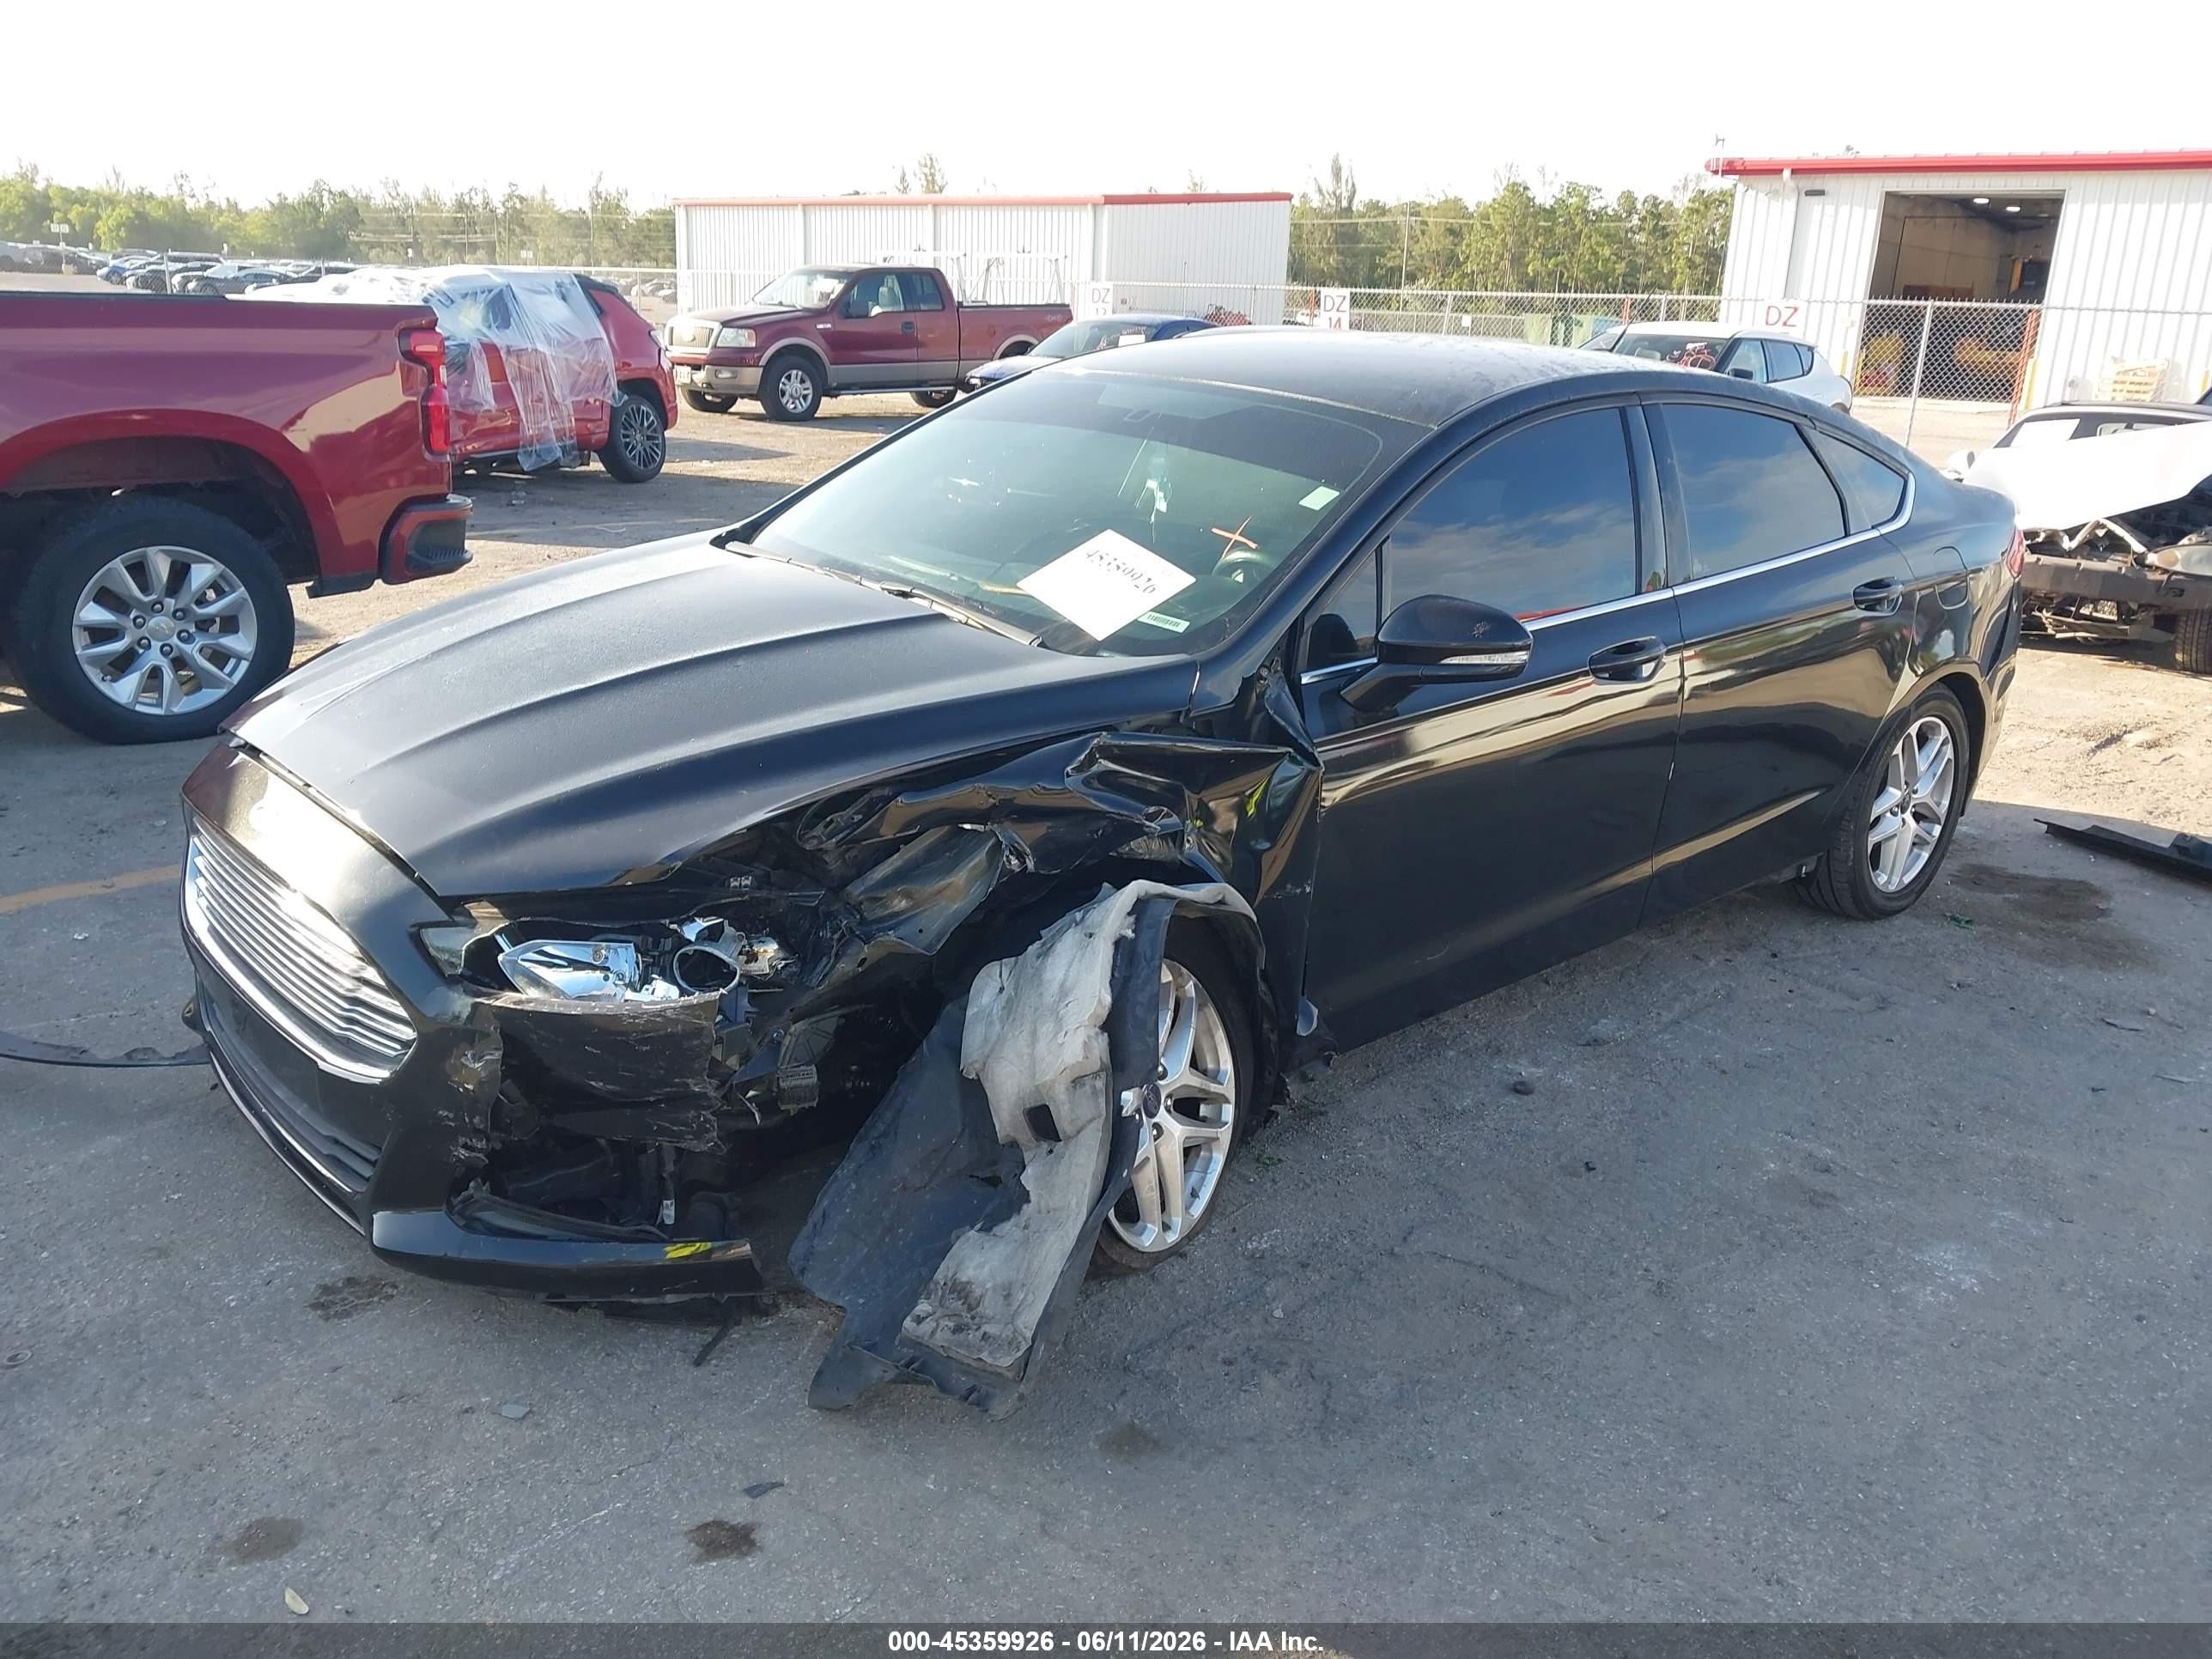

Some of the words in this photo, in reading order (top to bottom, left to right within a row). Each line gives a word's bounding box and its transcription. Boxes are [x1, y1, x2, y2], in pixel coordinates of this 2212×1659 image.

[1091, 288, 1110, 304] DZ
[1323, 295, 1346, 313] DZ
[1765, 305, 1799, 327] DZ
